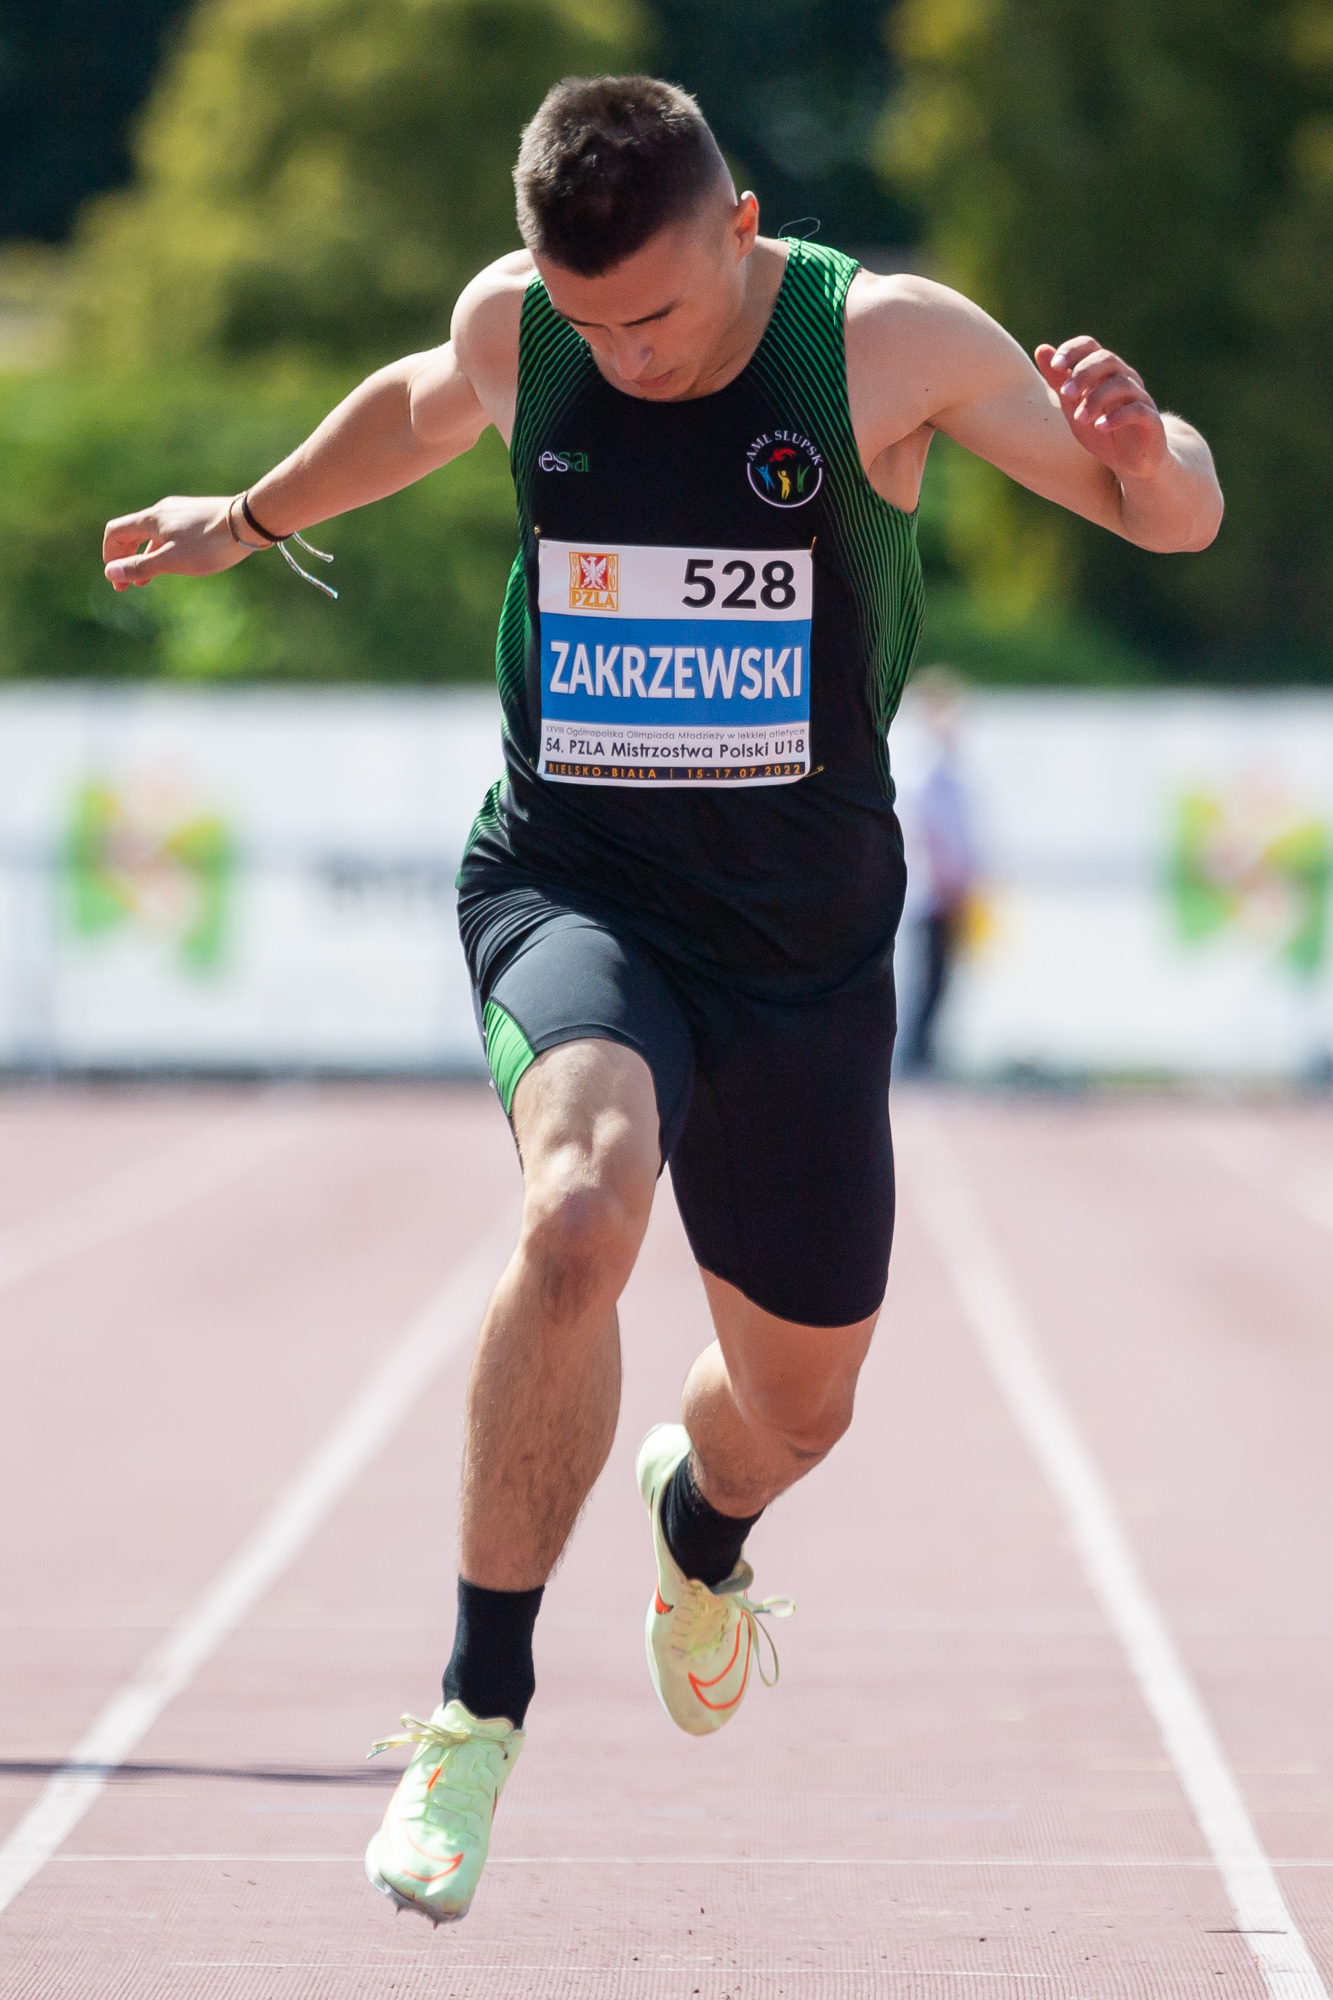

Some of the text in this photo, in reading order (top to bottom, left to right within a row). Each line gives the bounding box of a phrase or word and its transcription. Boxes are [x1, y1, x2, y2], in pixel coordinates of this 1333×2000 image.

[746, 434, 773, 462] AML
[681, 558, 797, 610] 528
[571, 590, 615, 609] PZLA
[549, 640, 802, 700] ZAKRZEWSKI
[566, 726, 624, 739] Ogólnopolska
[626, 730, 675, 740] Olimpiada
[678, 731, 725, 741] Młodzieży
[769, 728, 806, 739] atletyce
[545, 737, 805, 759] 54. PZLA Mistrzostwa Polski U18
[548, 762, 800, 779] BIELSKO-BIAŁA 15-17.07.2022
